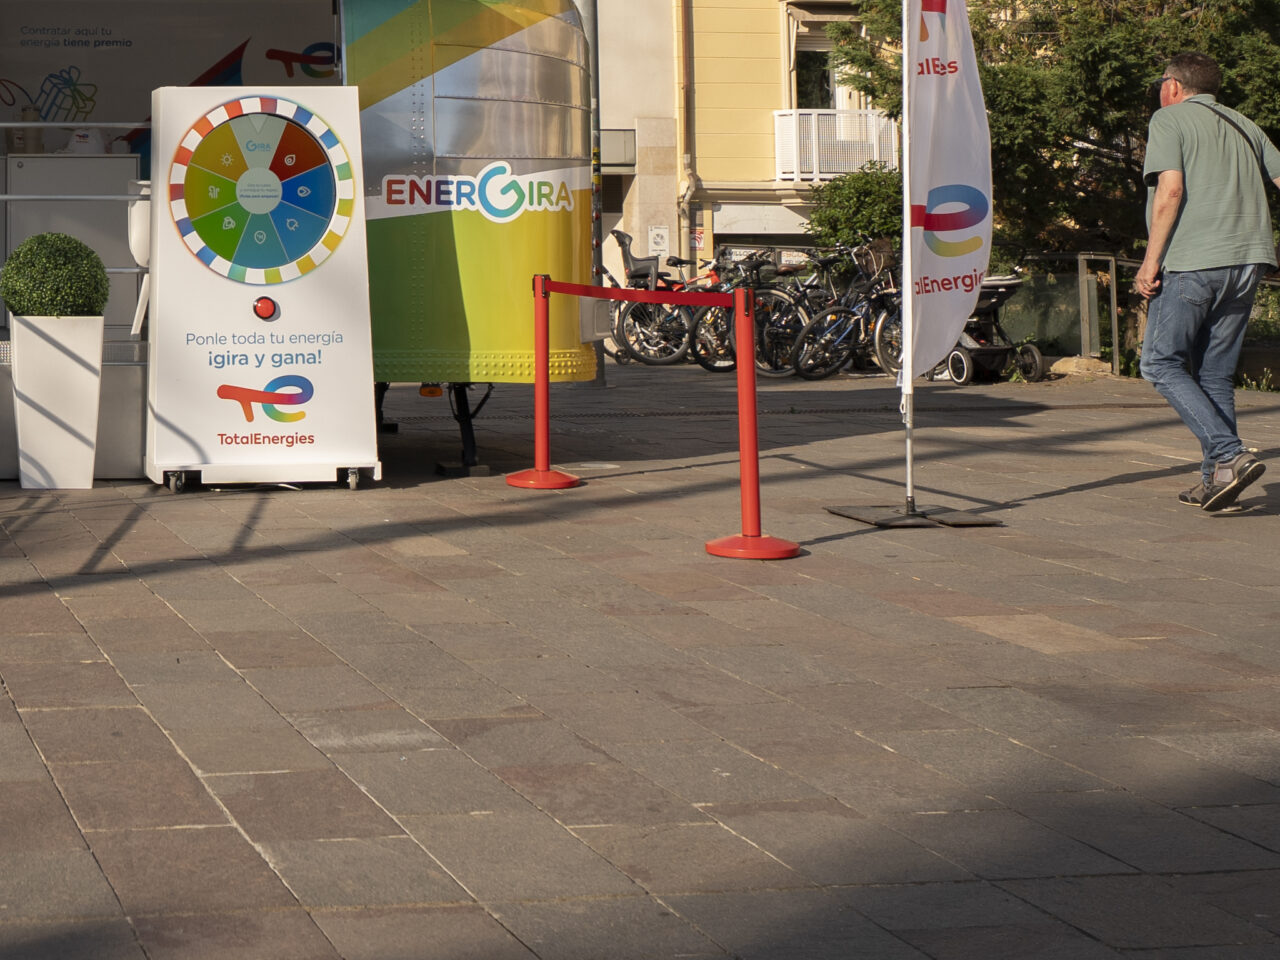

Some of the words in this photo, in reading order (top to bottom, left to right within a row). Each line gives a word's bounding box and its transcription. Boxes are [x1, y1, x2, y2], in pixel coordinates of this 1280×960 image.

[20, 26, 71, 36] Contratar
[74, 26, 98, 38] aquí
[101, 27, 112, 36] tu
[20, 38, 60, 48] energía
[63, 38, 90, 47] tiene
[93, 38, 133, 48] premio
[386, 166, 571, 218] ENERGIRA
[186, 332, 227, 346] Ponle
[232, 332, 265, 345] toda
[270, 333, 284, 345] tu
[289, 331, 343, 346] energía
[208, 351, 248, 368] ¡gira
[254, 353, 265, 368] y
[271, 349, 322, 368] gana!
[217, 432, 315, 447] TotalEnergies
